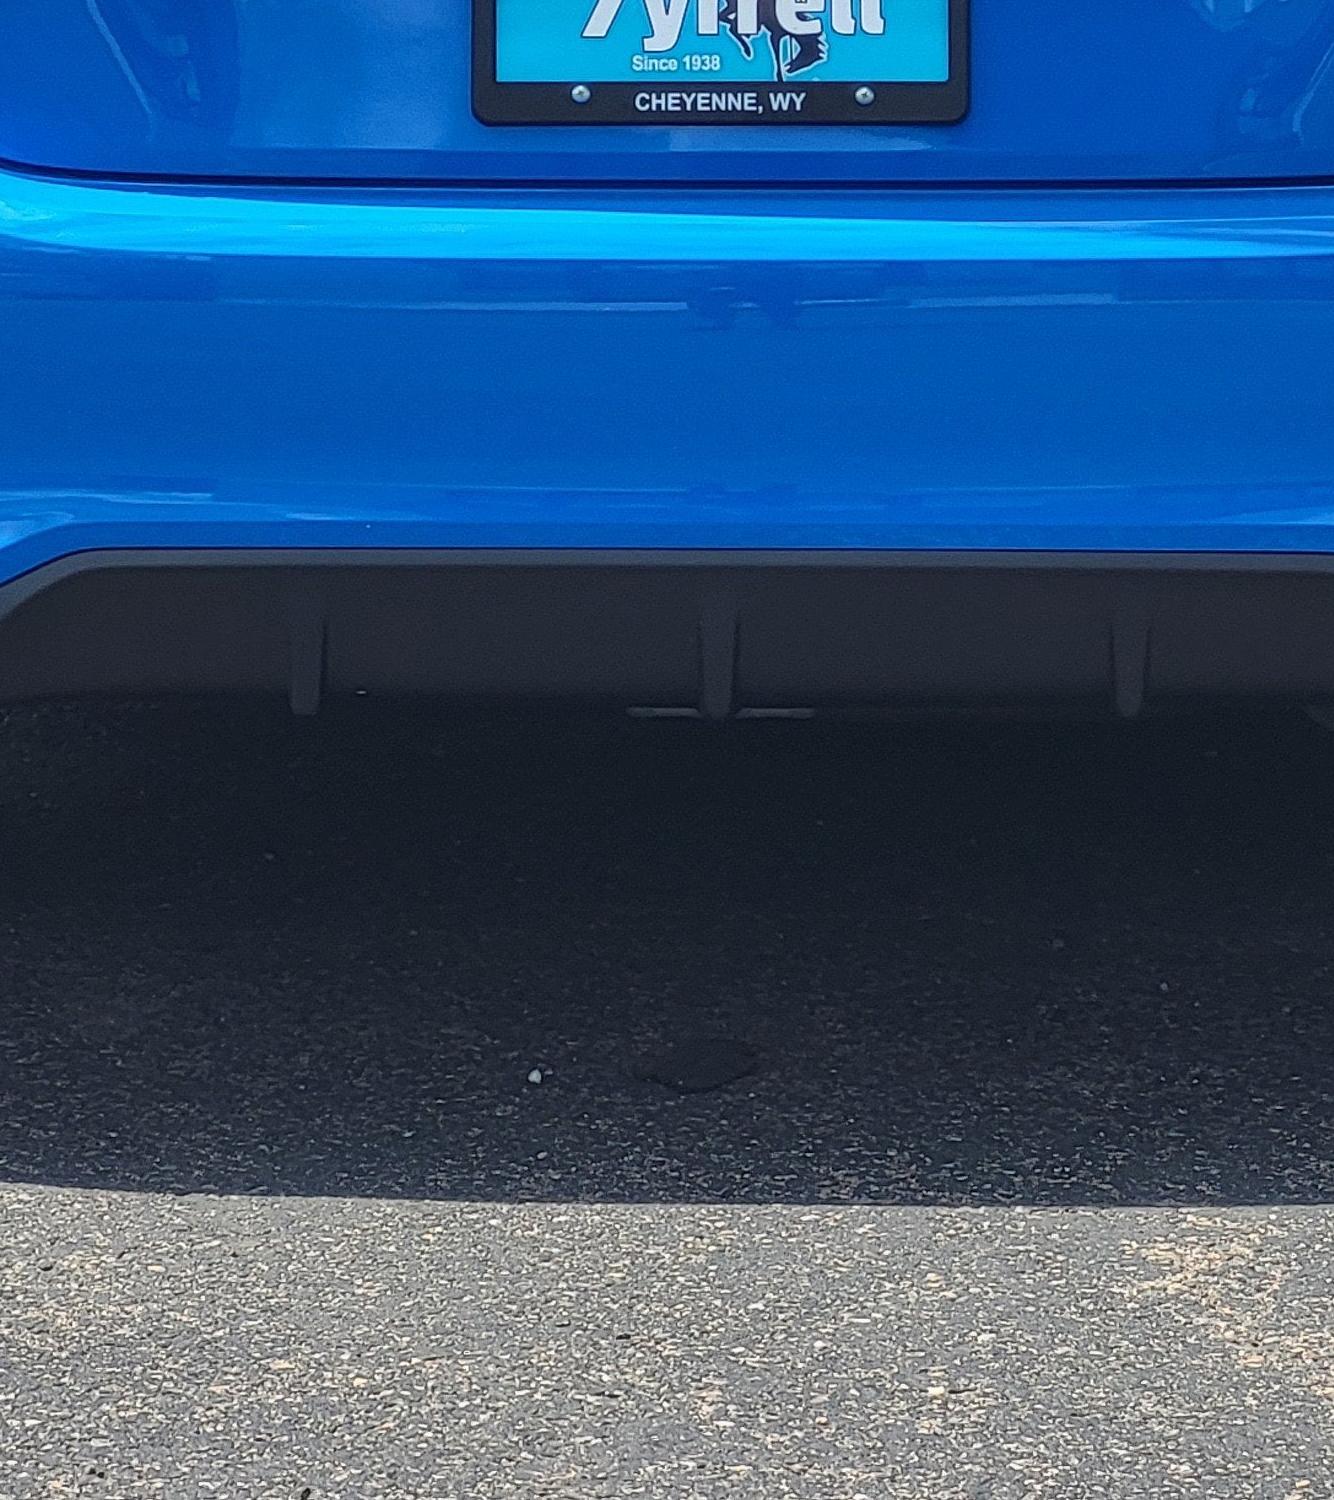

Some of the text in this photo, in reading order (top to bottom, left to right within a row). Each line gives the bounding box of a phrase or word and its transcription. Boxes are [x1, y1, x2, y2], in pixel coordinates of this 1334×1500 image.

[631, 54, 721, 71] Since 1938
[634, 92, 807, 114] CHEYENNE, WY
